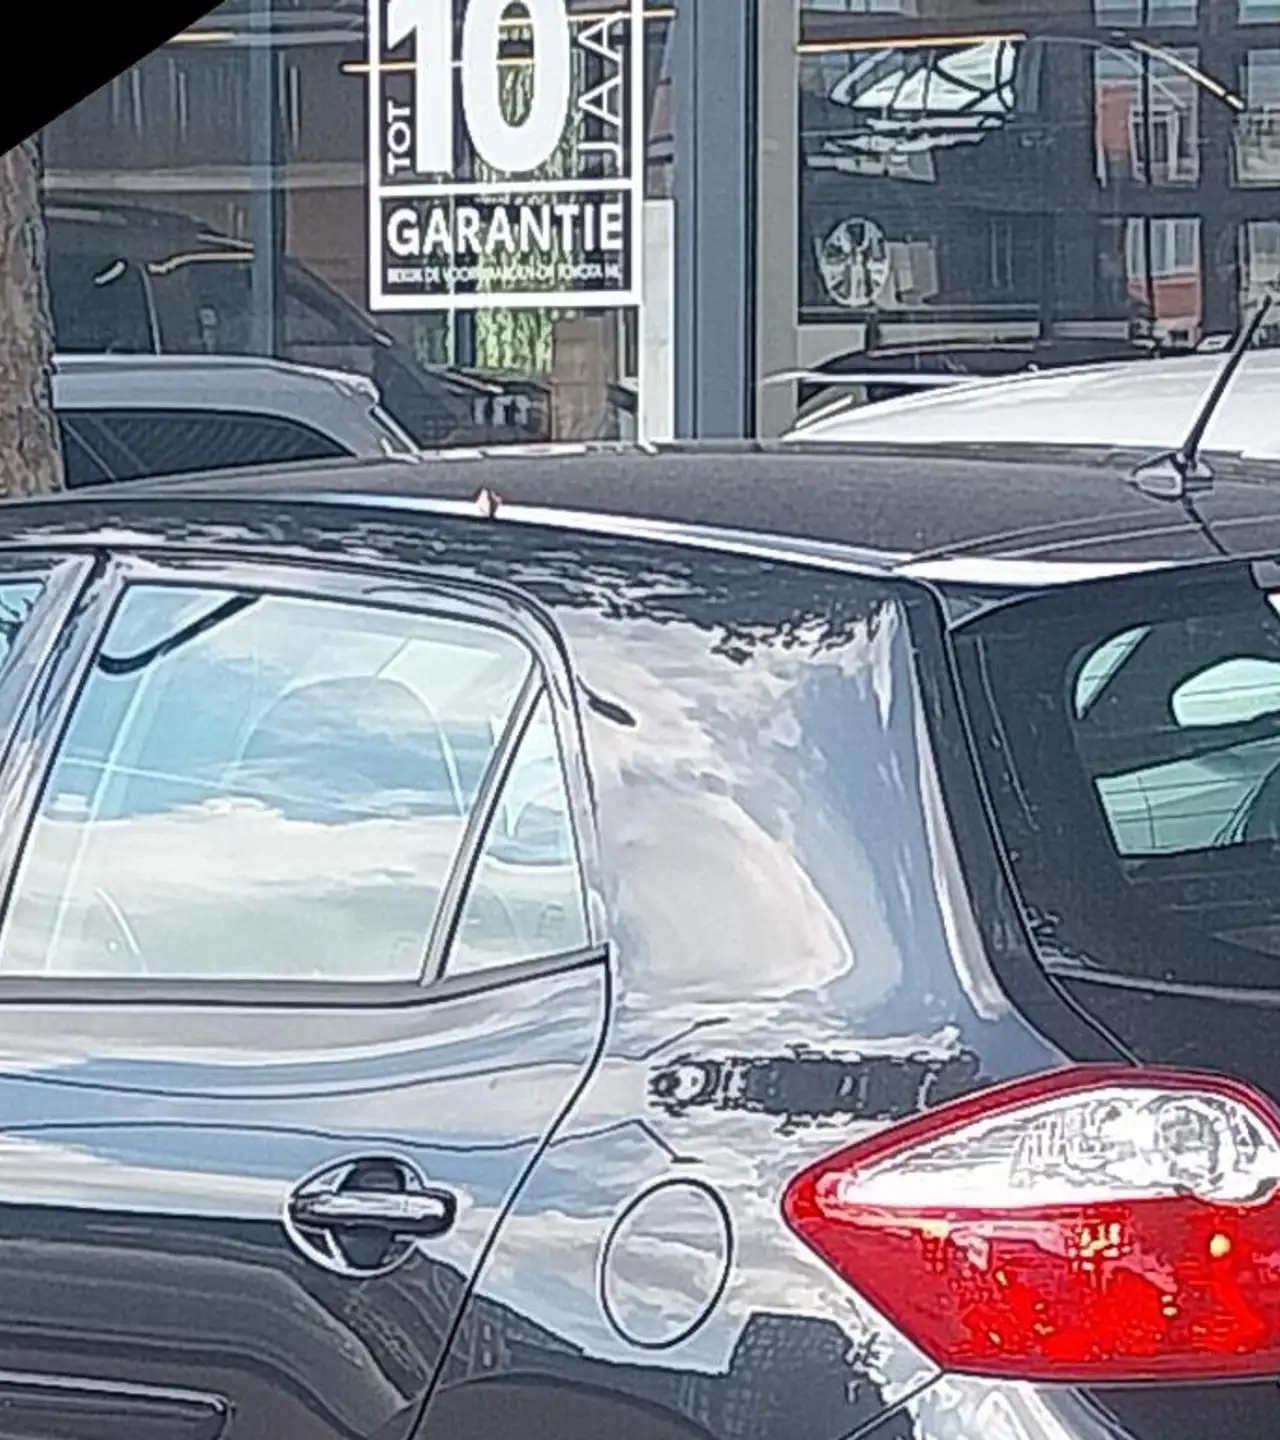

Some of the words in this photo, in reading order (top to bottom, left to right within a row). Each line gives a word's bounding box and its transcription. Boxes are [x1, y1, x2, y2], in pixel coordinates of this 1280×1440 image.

[387, 0, 571, 173] 10
[386, 100, 411, 176] TOT
[386, 203, 624, 257] GARANTIE
